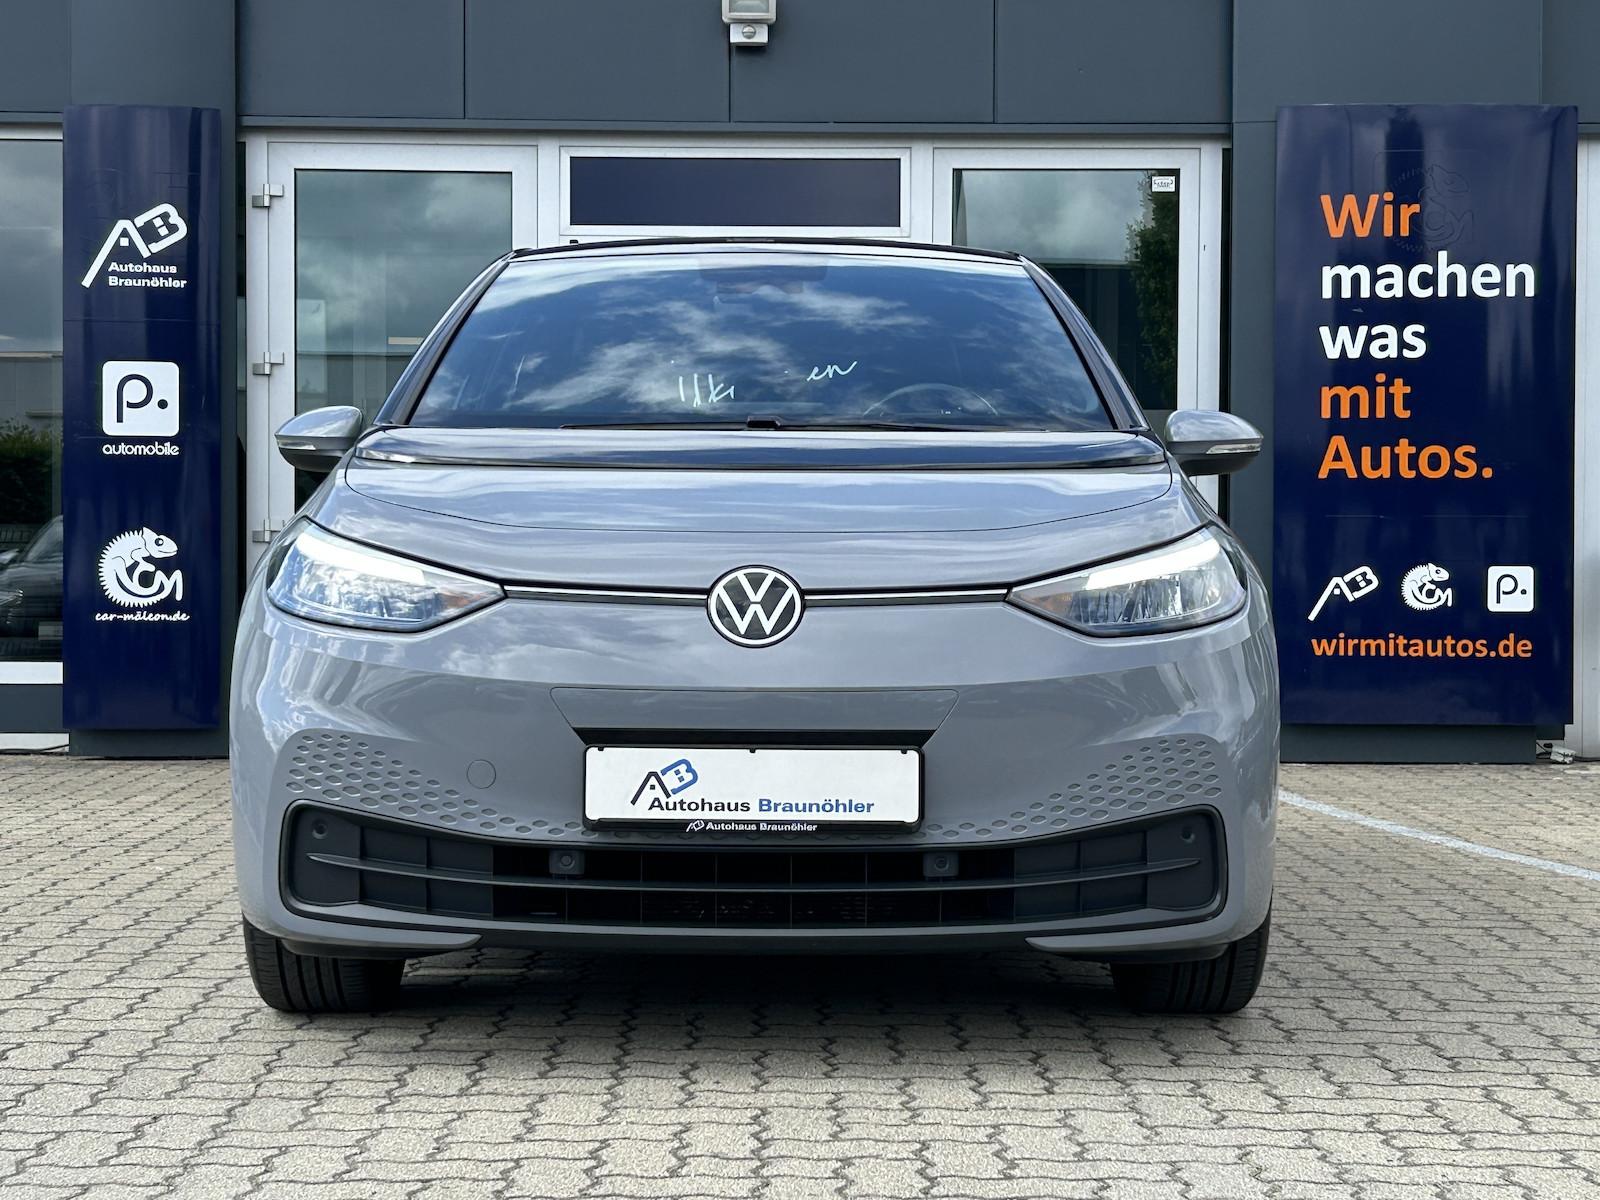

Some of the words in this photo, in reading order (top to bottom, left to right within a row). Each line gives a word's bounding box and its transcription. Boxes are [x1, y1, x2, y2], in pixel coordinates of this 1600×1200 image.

[1320, 191, 1421, 238] Wir
[107, 261, 178, 274] Autohaus
[1321, 250, 1536, 299] machen
[108, 275, 188, 289] Braunöhler
[1318, 323, 1427, 359] was
[1320, 373, 1411, 419] mit
[102, 441, 180, 456] automobile
[1317, 434, 1493, 479] Autos.
[95, 610, 190, 622] car-mäleon.de
[1311, 632, 1533, 658] wirmitautos.de
[648, 798, 751, 813] Autohaus
[758, 798, 875, 814] Braunöhler
[705, 821, 757, 832] Autohaus
[759, 822, 818, 832] Braunöhler
